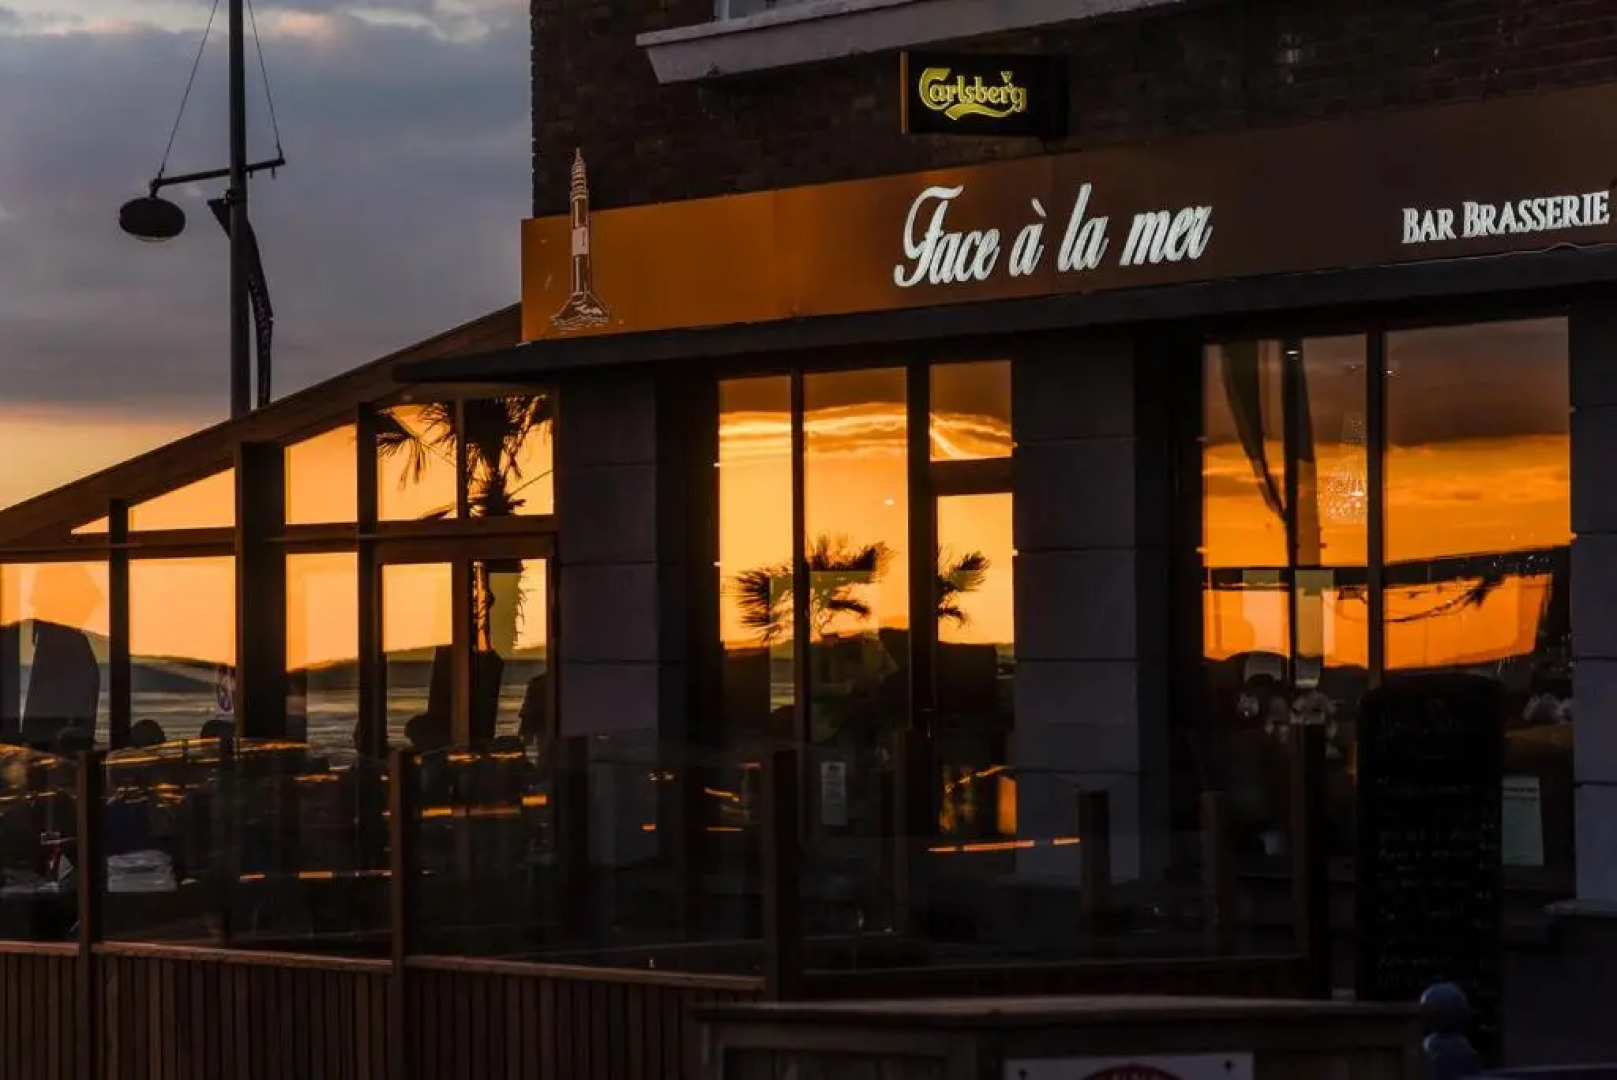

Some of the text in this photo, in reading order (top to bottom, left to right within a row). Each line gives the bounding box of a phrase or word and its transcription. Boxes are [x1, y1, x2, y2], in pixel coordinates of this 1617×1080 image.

[918, 67, 1028, 117] Carlsberg
[894, 183, 1212, 286] Face à la mer
[1402, 190, 1609, 243] BAR BRASSERIE
